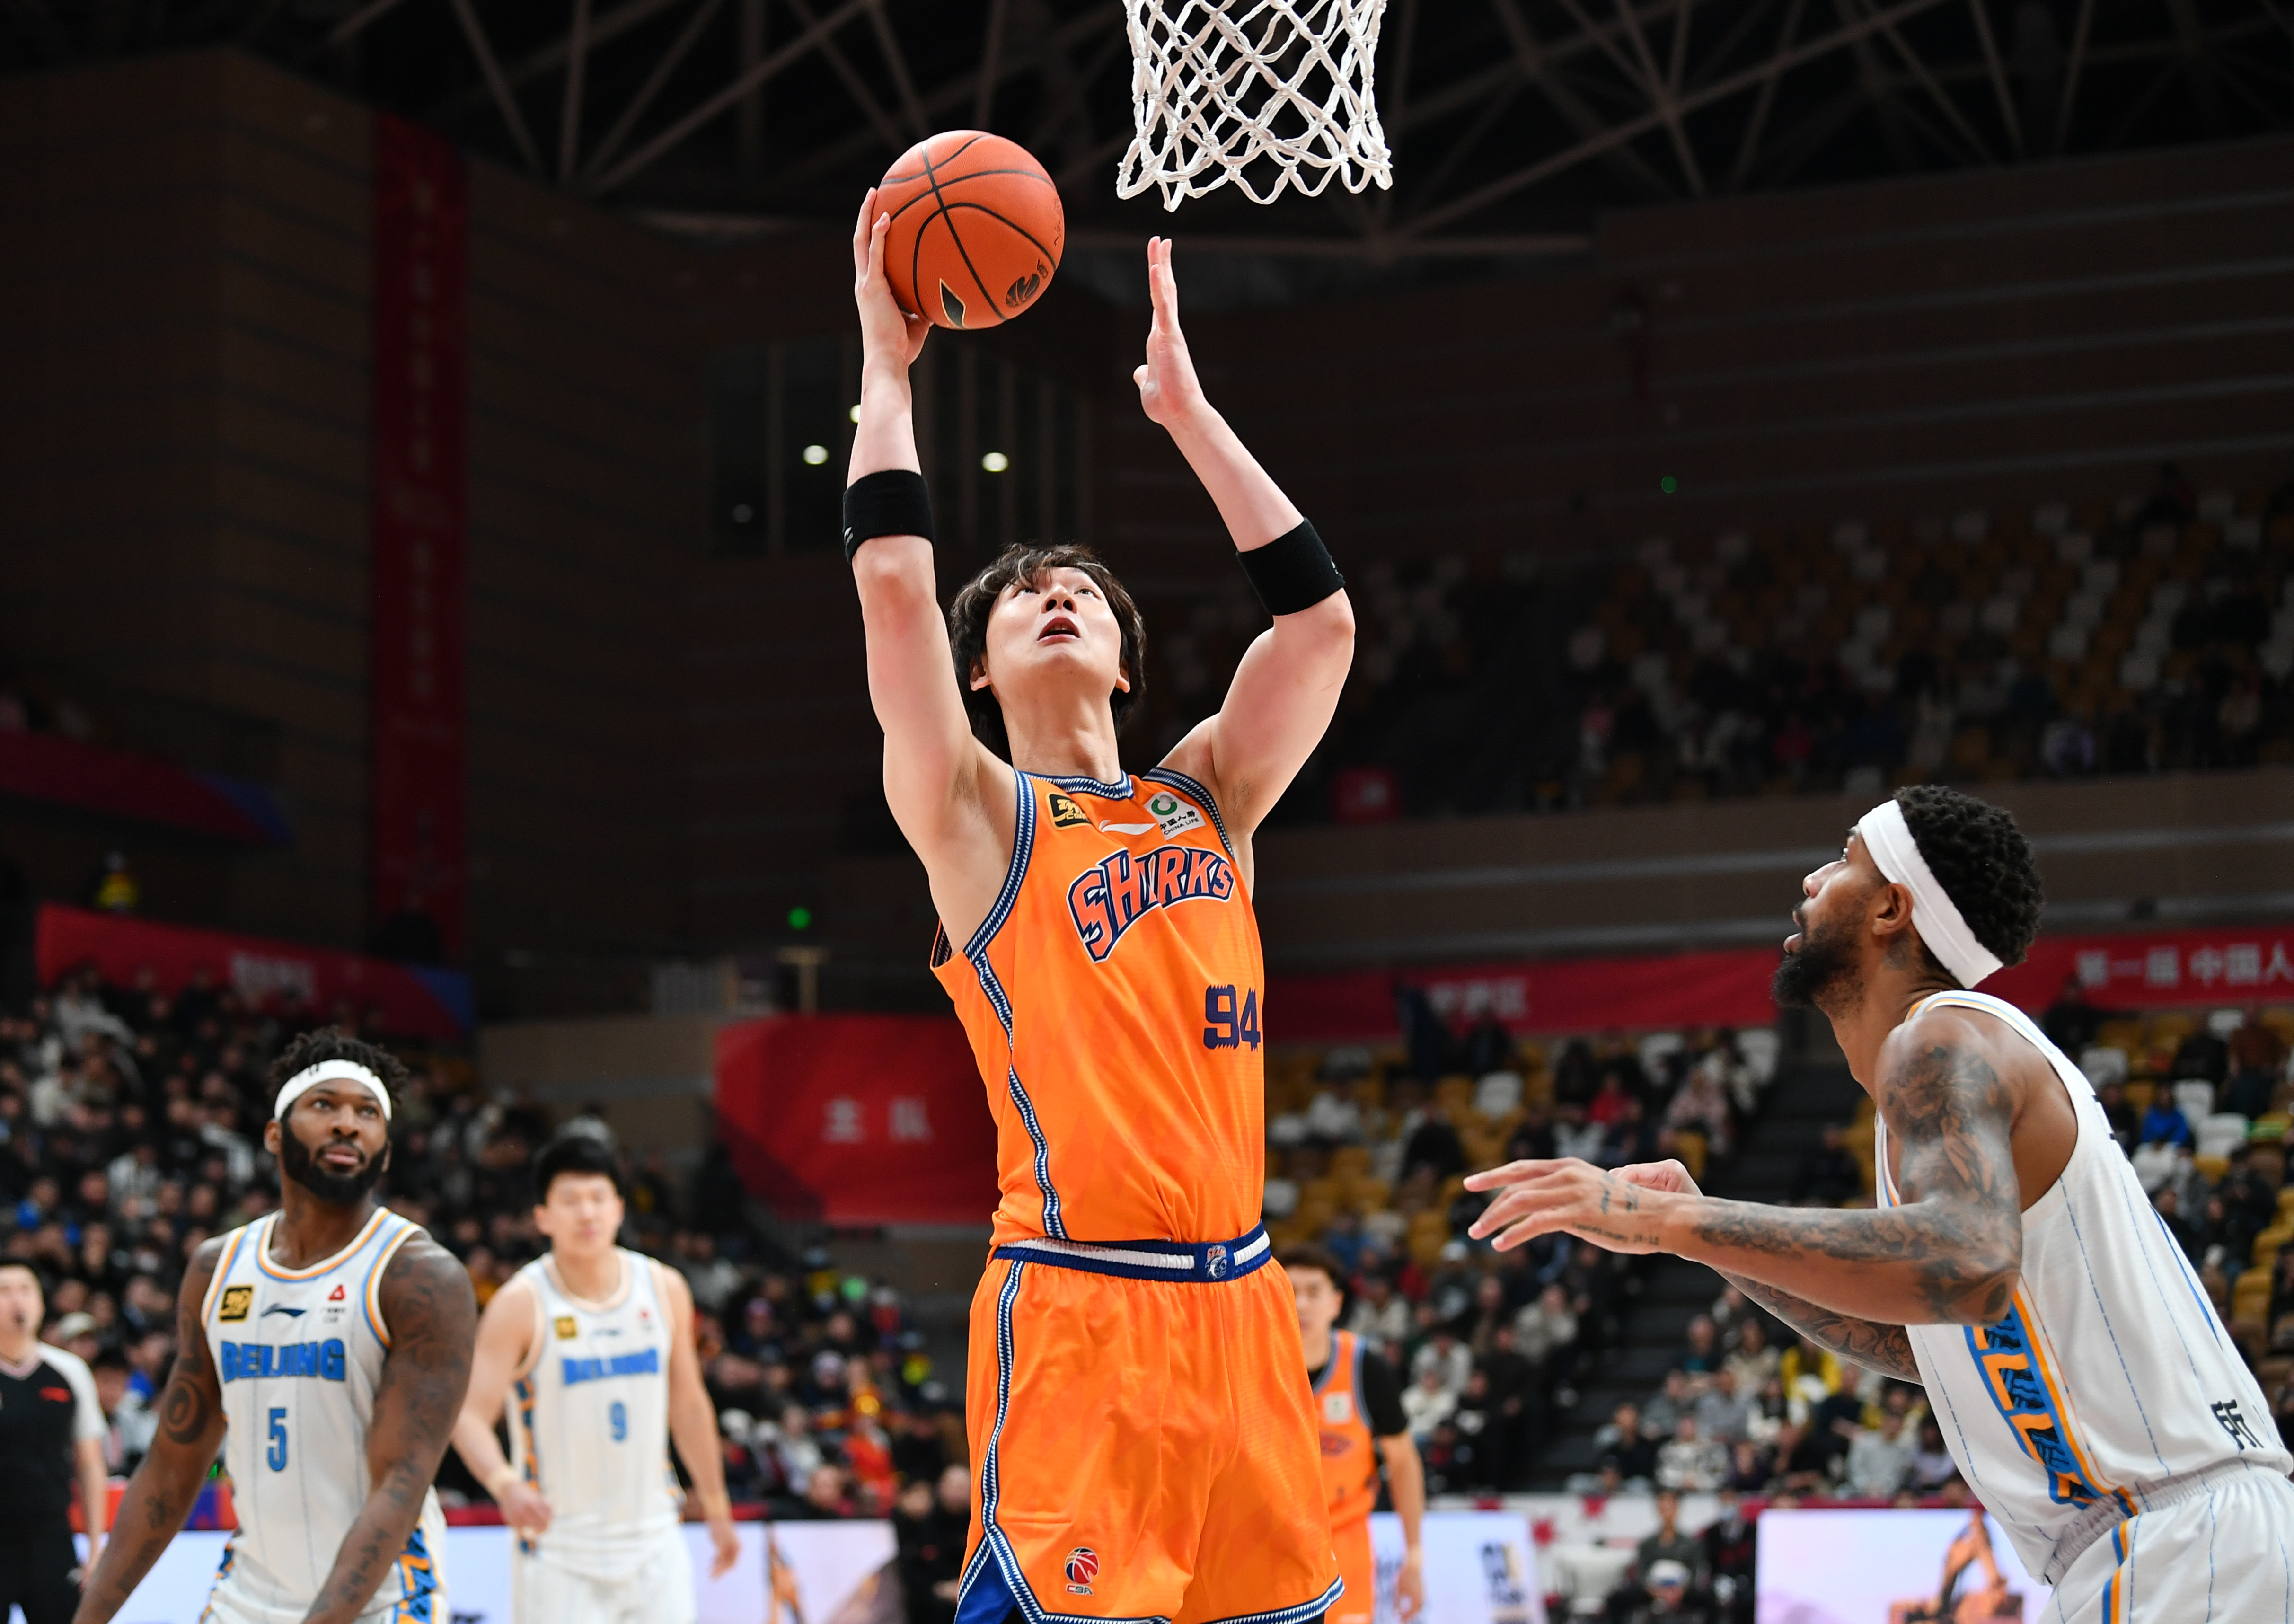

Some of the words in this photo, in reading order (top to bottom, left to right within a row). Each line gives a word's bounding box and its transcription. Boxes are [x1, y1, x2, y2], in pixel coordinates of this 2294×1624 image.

[1164, 823, 1184, 835] CHINA
[1185, 817, 1200, 825] LIFE
[1203, 984, 1261, 1052] 94
[221, 1338, 346, 1383] BEIJING
[267, 1407, 288, 1472] 5
[1066, 1584, 1094, 1596] CBA
